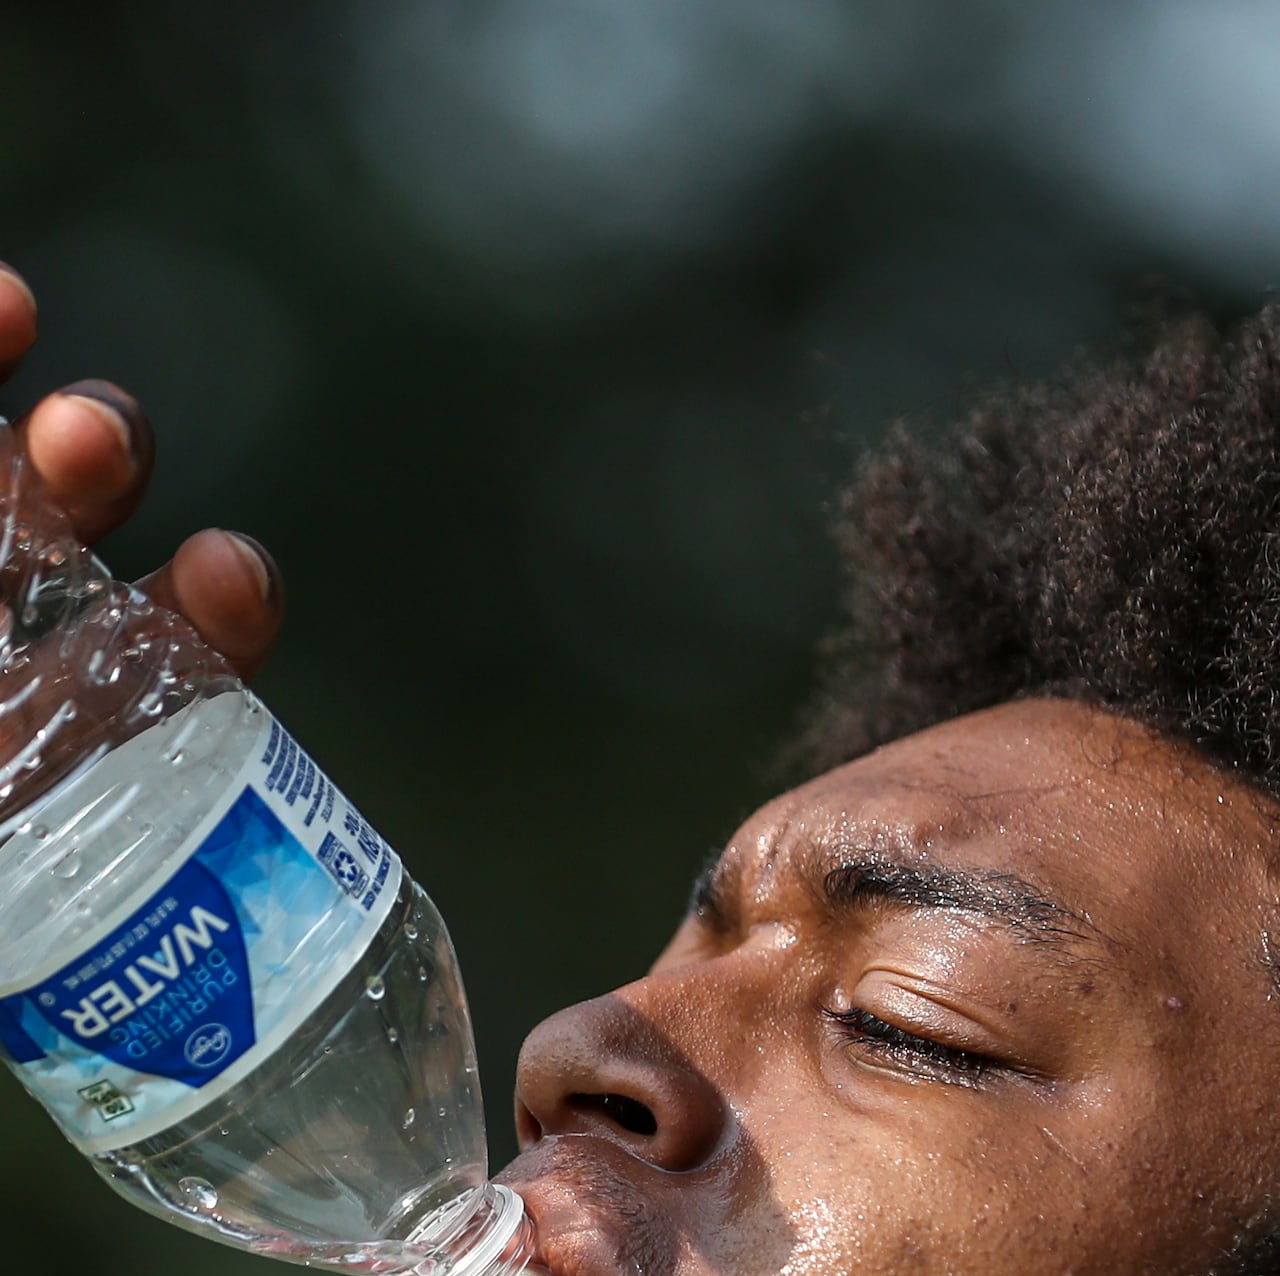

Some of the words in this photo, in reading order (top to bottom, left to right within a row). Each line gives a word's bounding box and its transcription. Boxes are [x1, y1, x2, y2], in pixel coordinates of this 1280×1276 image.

[59, 906, 230, 1039] WATER
[109, 947, 227, 1047] DRINKING
[127, 965, 238, 1057] PURIFIED
[188, 1029, 224, 1061] Kroger
